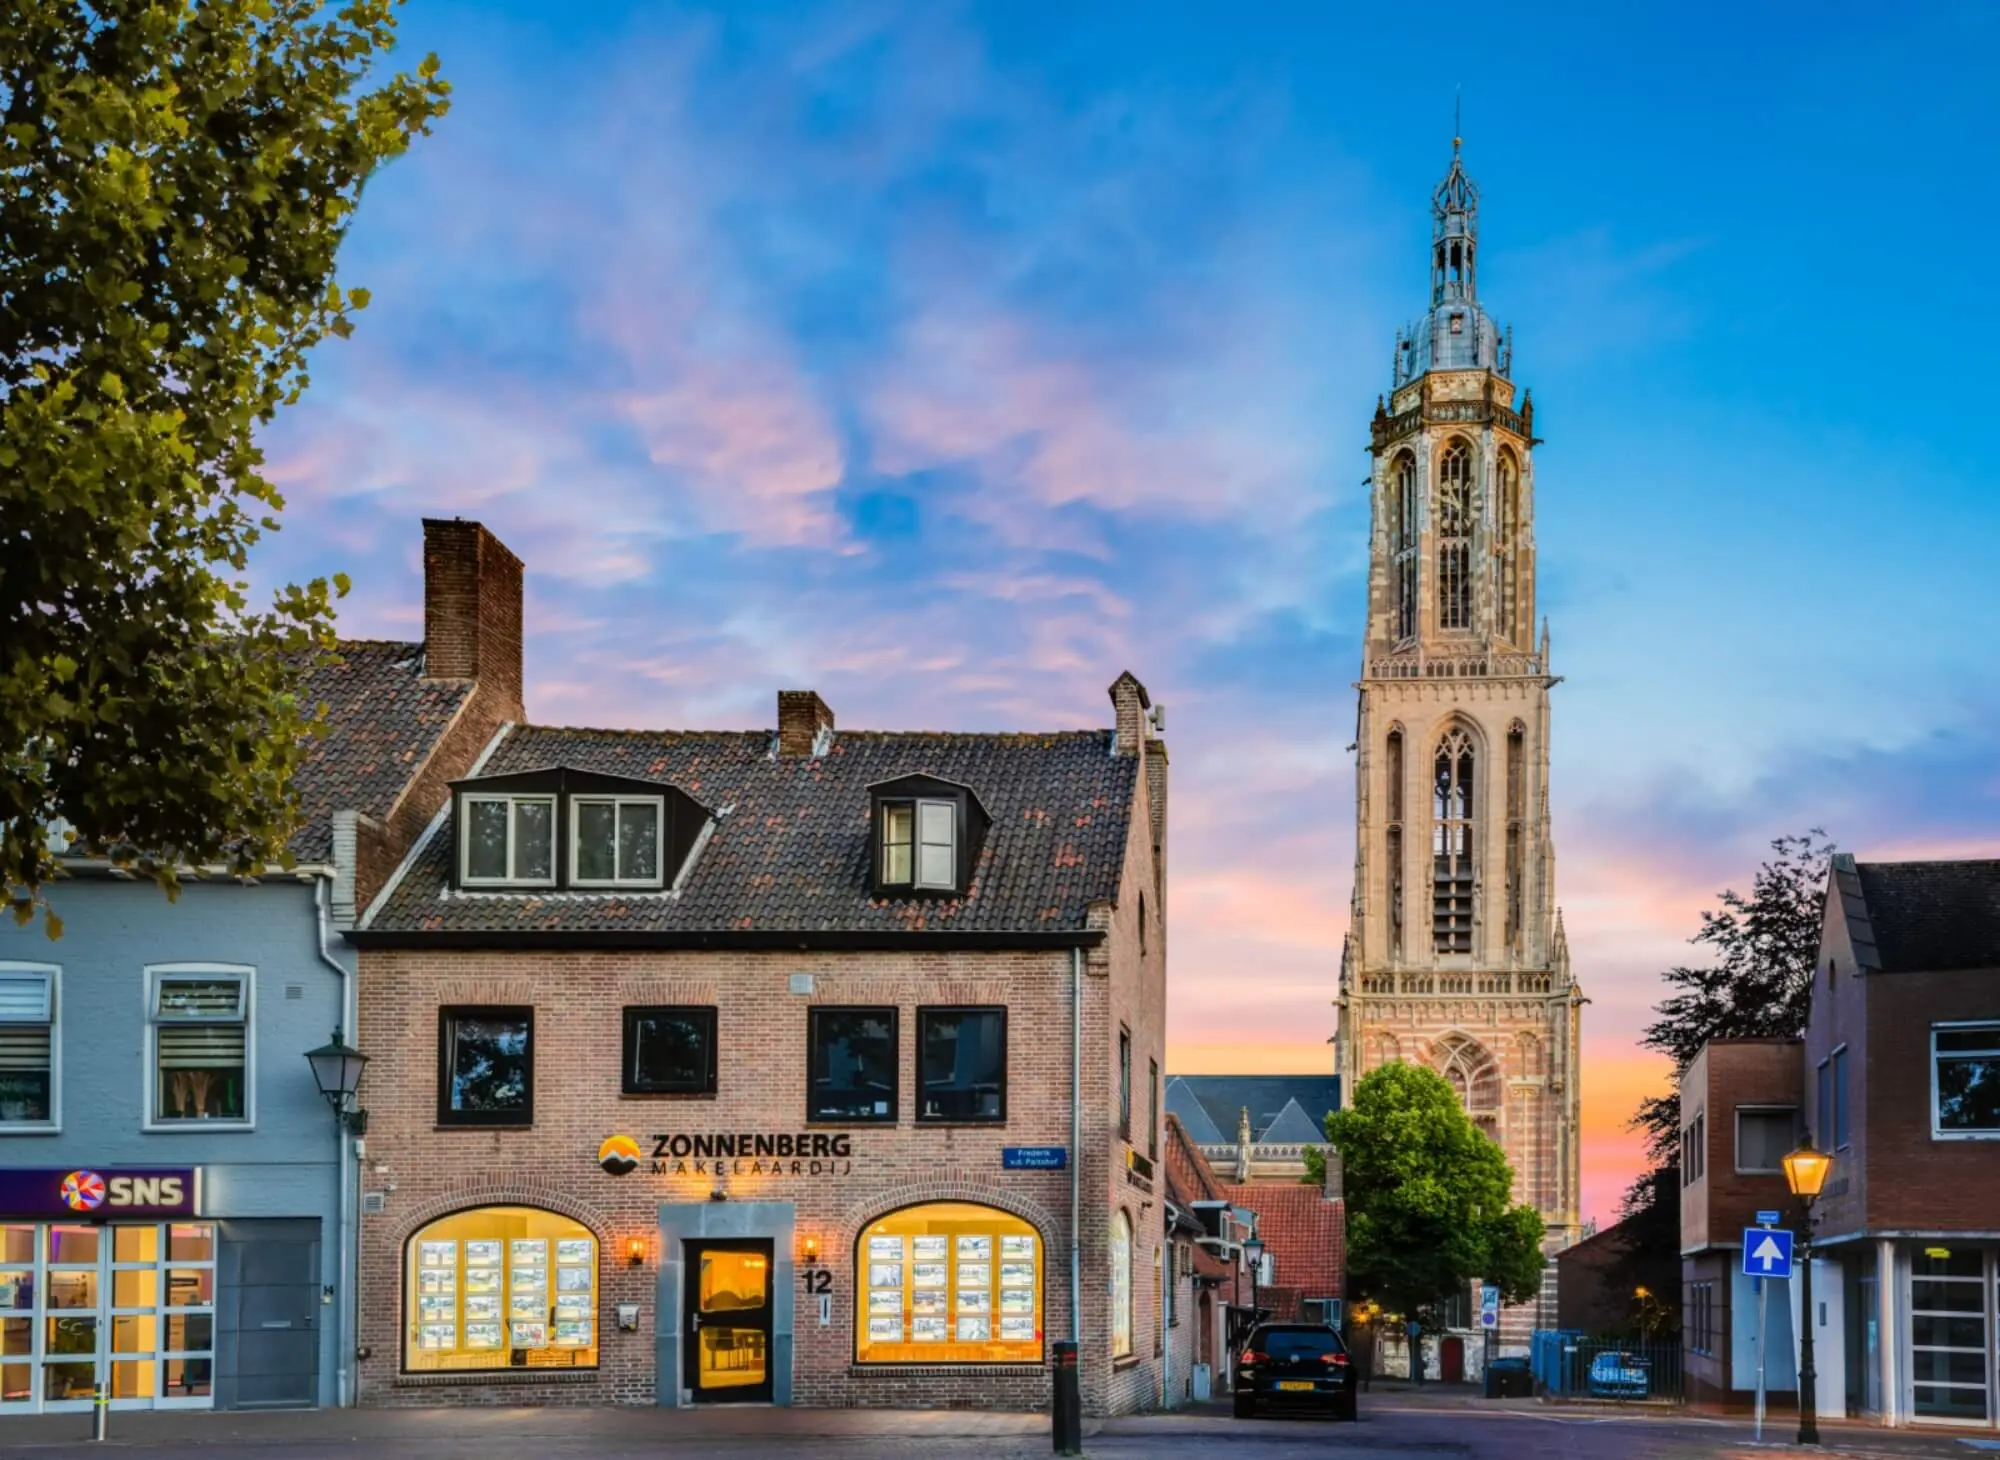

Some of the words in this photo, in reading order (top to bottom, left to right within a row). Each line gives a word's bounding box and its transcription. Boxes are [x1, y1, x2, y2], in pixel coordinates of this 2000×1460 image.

[651, 1134, 850, 1157] ZONNENBERG
[651, 1160, 850, 1175] MAKELAARDIJ
[109, 1177, 183, 1205] SNS
[802, 1270, 832, 1294] 12
